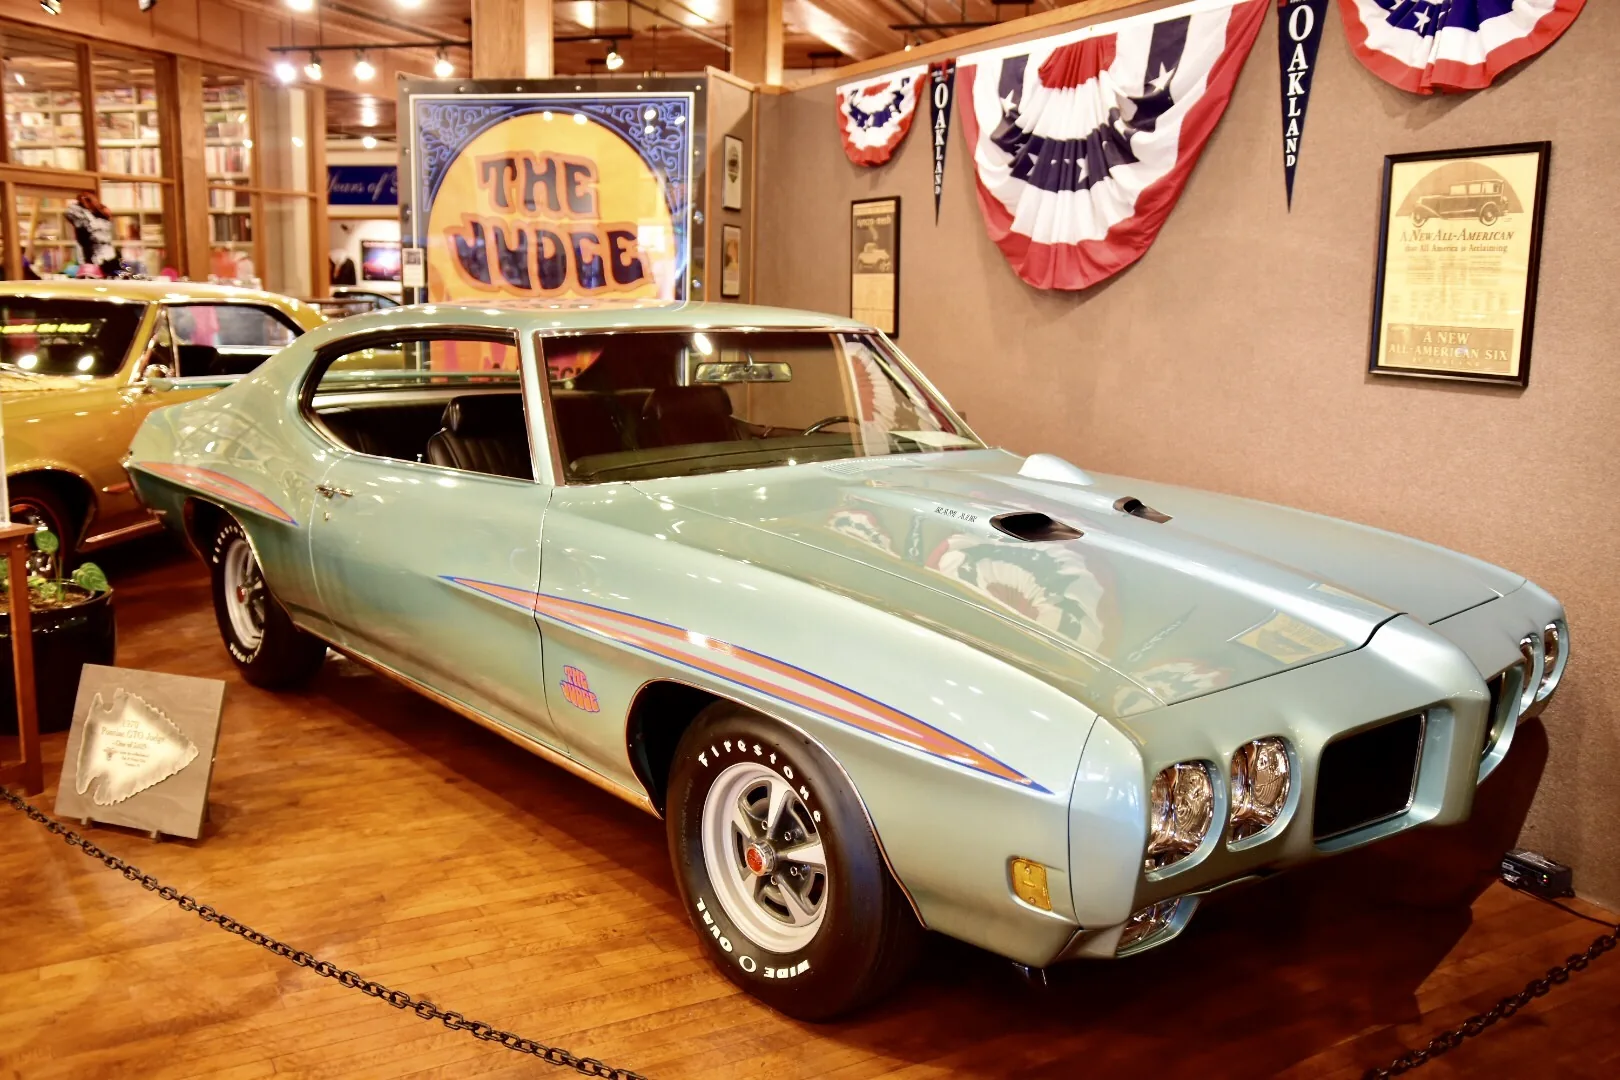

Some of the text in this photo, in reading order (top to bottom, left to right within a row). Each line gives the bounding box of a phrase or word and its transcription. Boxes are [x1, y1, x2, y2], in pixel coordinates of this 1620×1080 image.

[1286, 5, 1315, 167] OAKLAND
[934, 82, 949, 195] OAKLAND
[368, 172, 388, 202] of
[477, 151, 600, 219] THE
[444, 214, 653, 295] JUDGE
[1431, 244, 1459, 252] America
[1388, 343, 1509, 361] ALL-AMERICAN SIX
[1423, 331, 1471, 345] A NEW
[697, 897, 811, 979] WIDE OVAL
